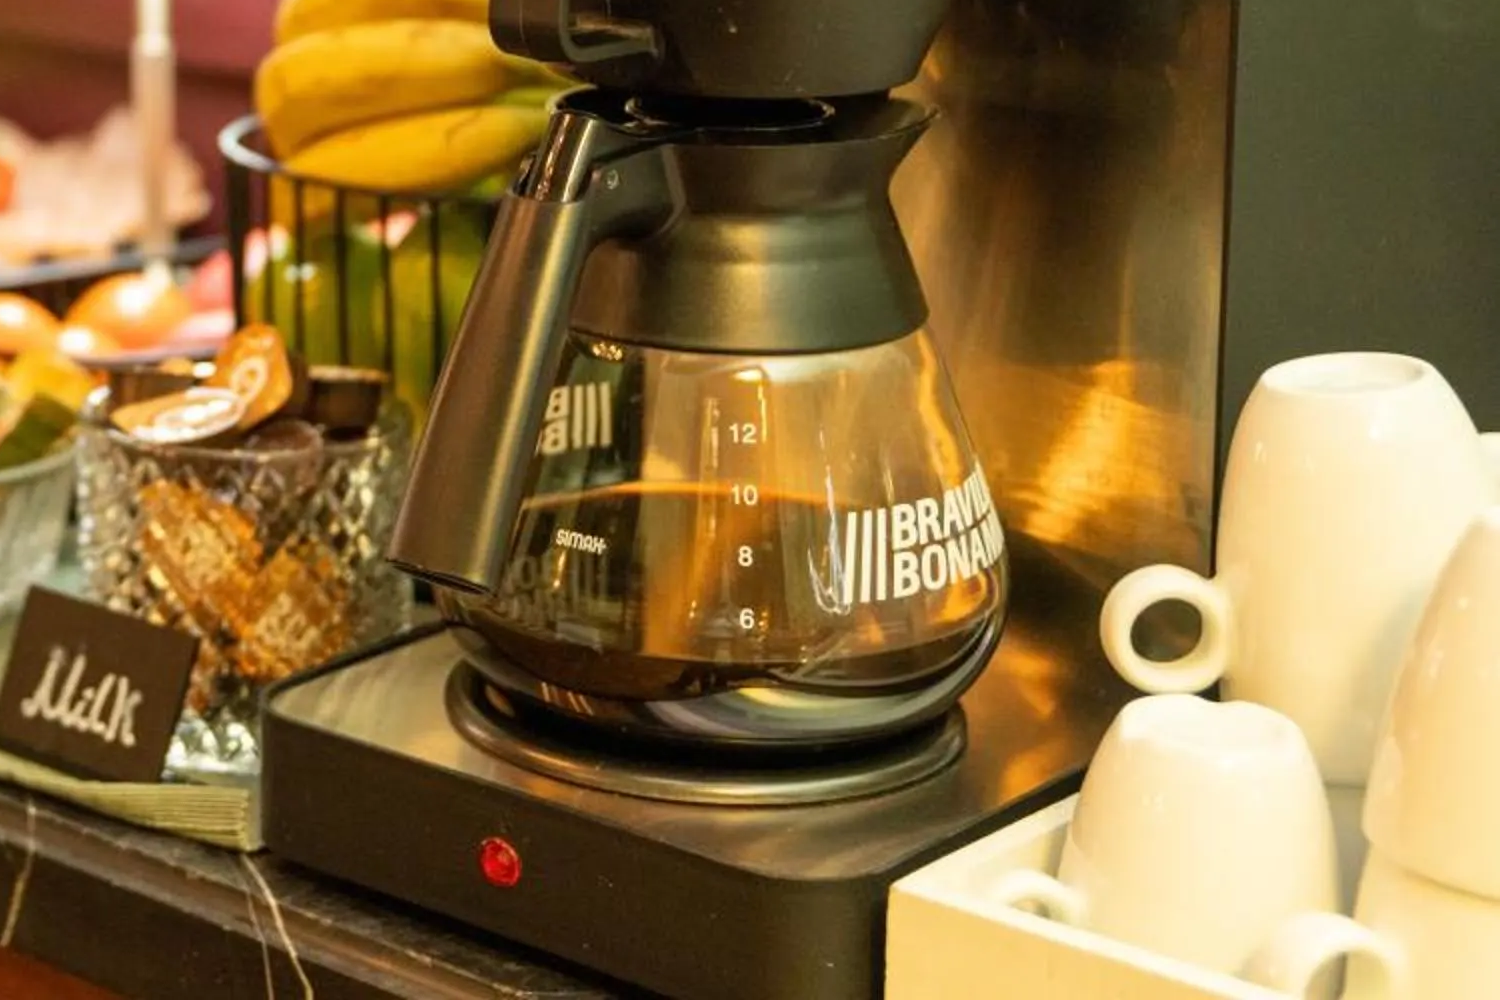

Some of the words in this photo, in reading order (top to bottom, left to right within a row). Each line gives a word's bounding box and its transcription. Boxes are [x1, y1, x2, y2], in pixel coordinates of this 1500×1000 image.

[729, 423, 757, 444] 12
[731, 484, 758, 505] 10
[738, 546, 753, 567] 8
[739, 608, 754, 629] 6
